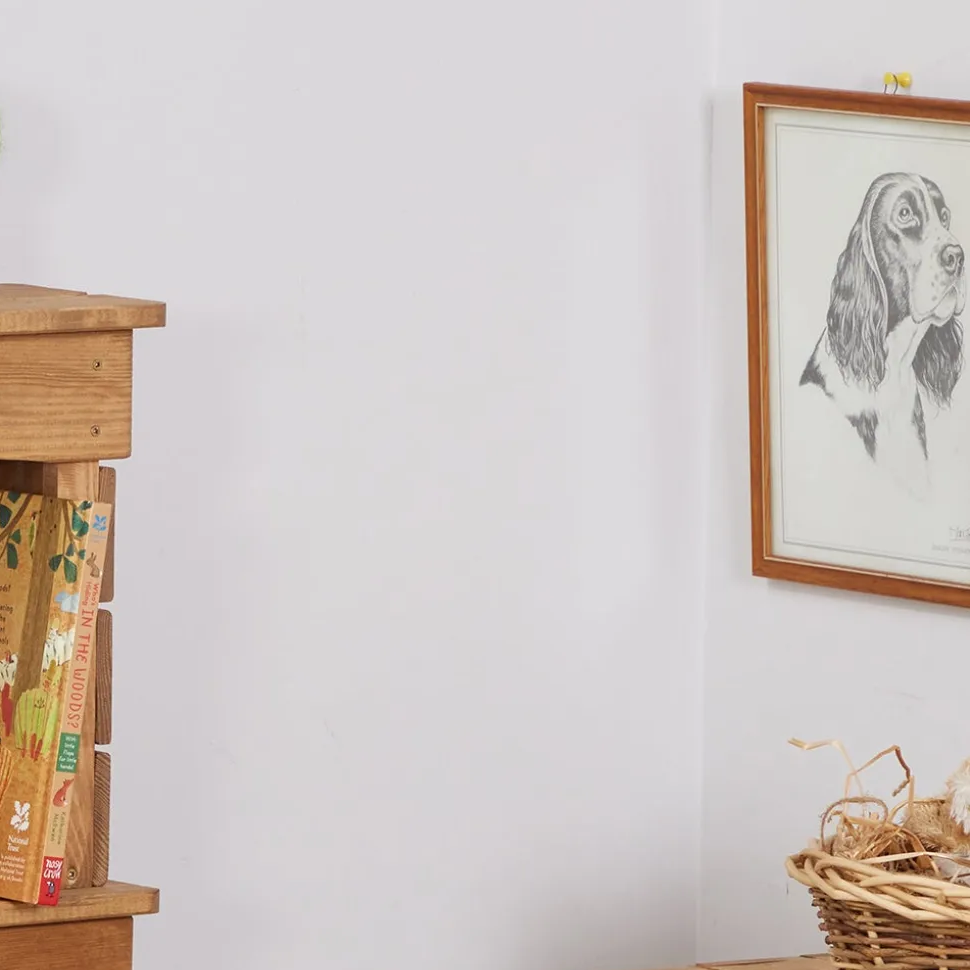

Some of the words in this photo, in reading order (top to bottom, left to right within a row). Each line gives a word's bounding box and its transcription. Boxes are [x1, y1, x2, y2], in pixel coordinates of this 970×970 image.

[81, 610, 95, 628] IN
[75, 634, 91, 664] THE
[66, 668, 87, 729] WOODS?
